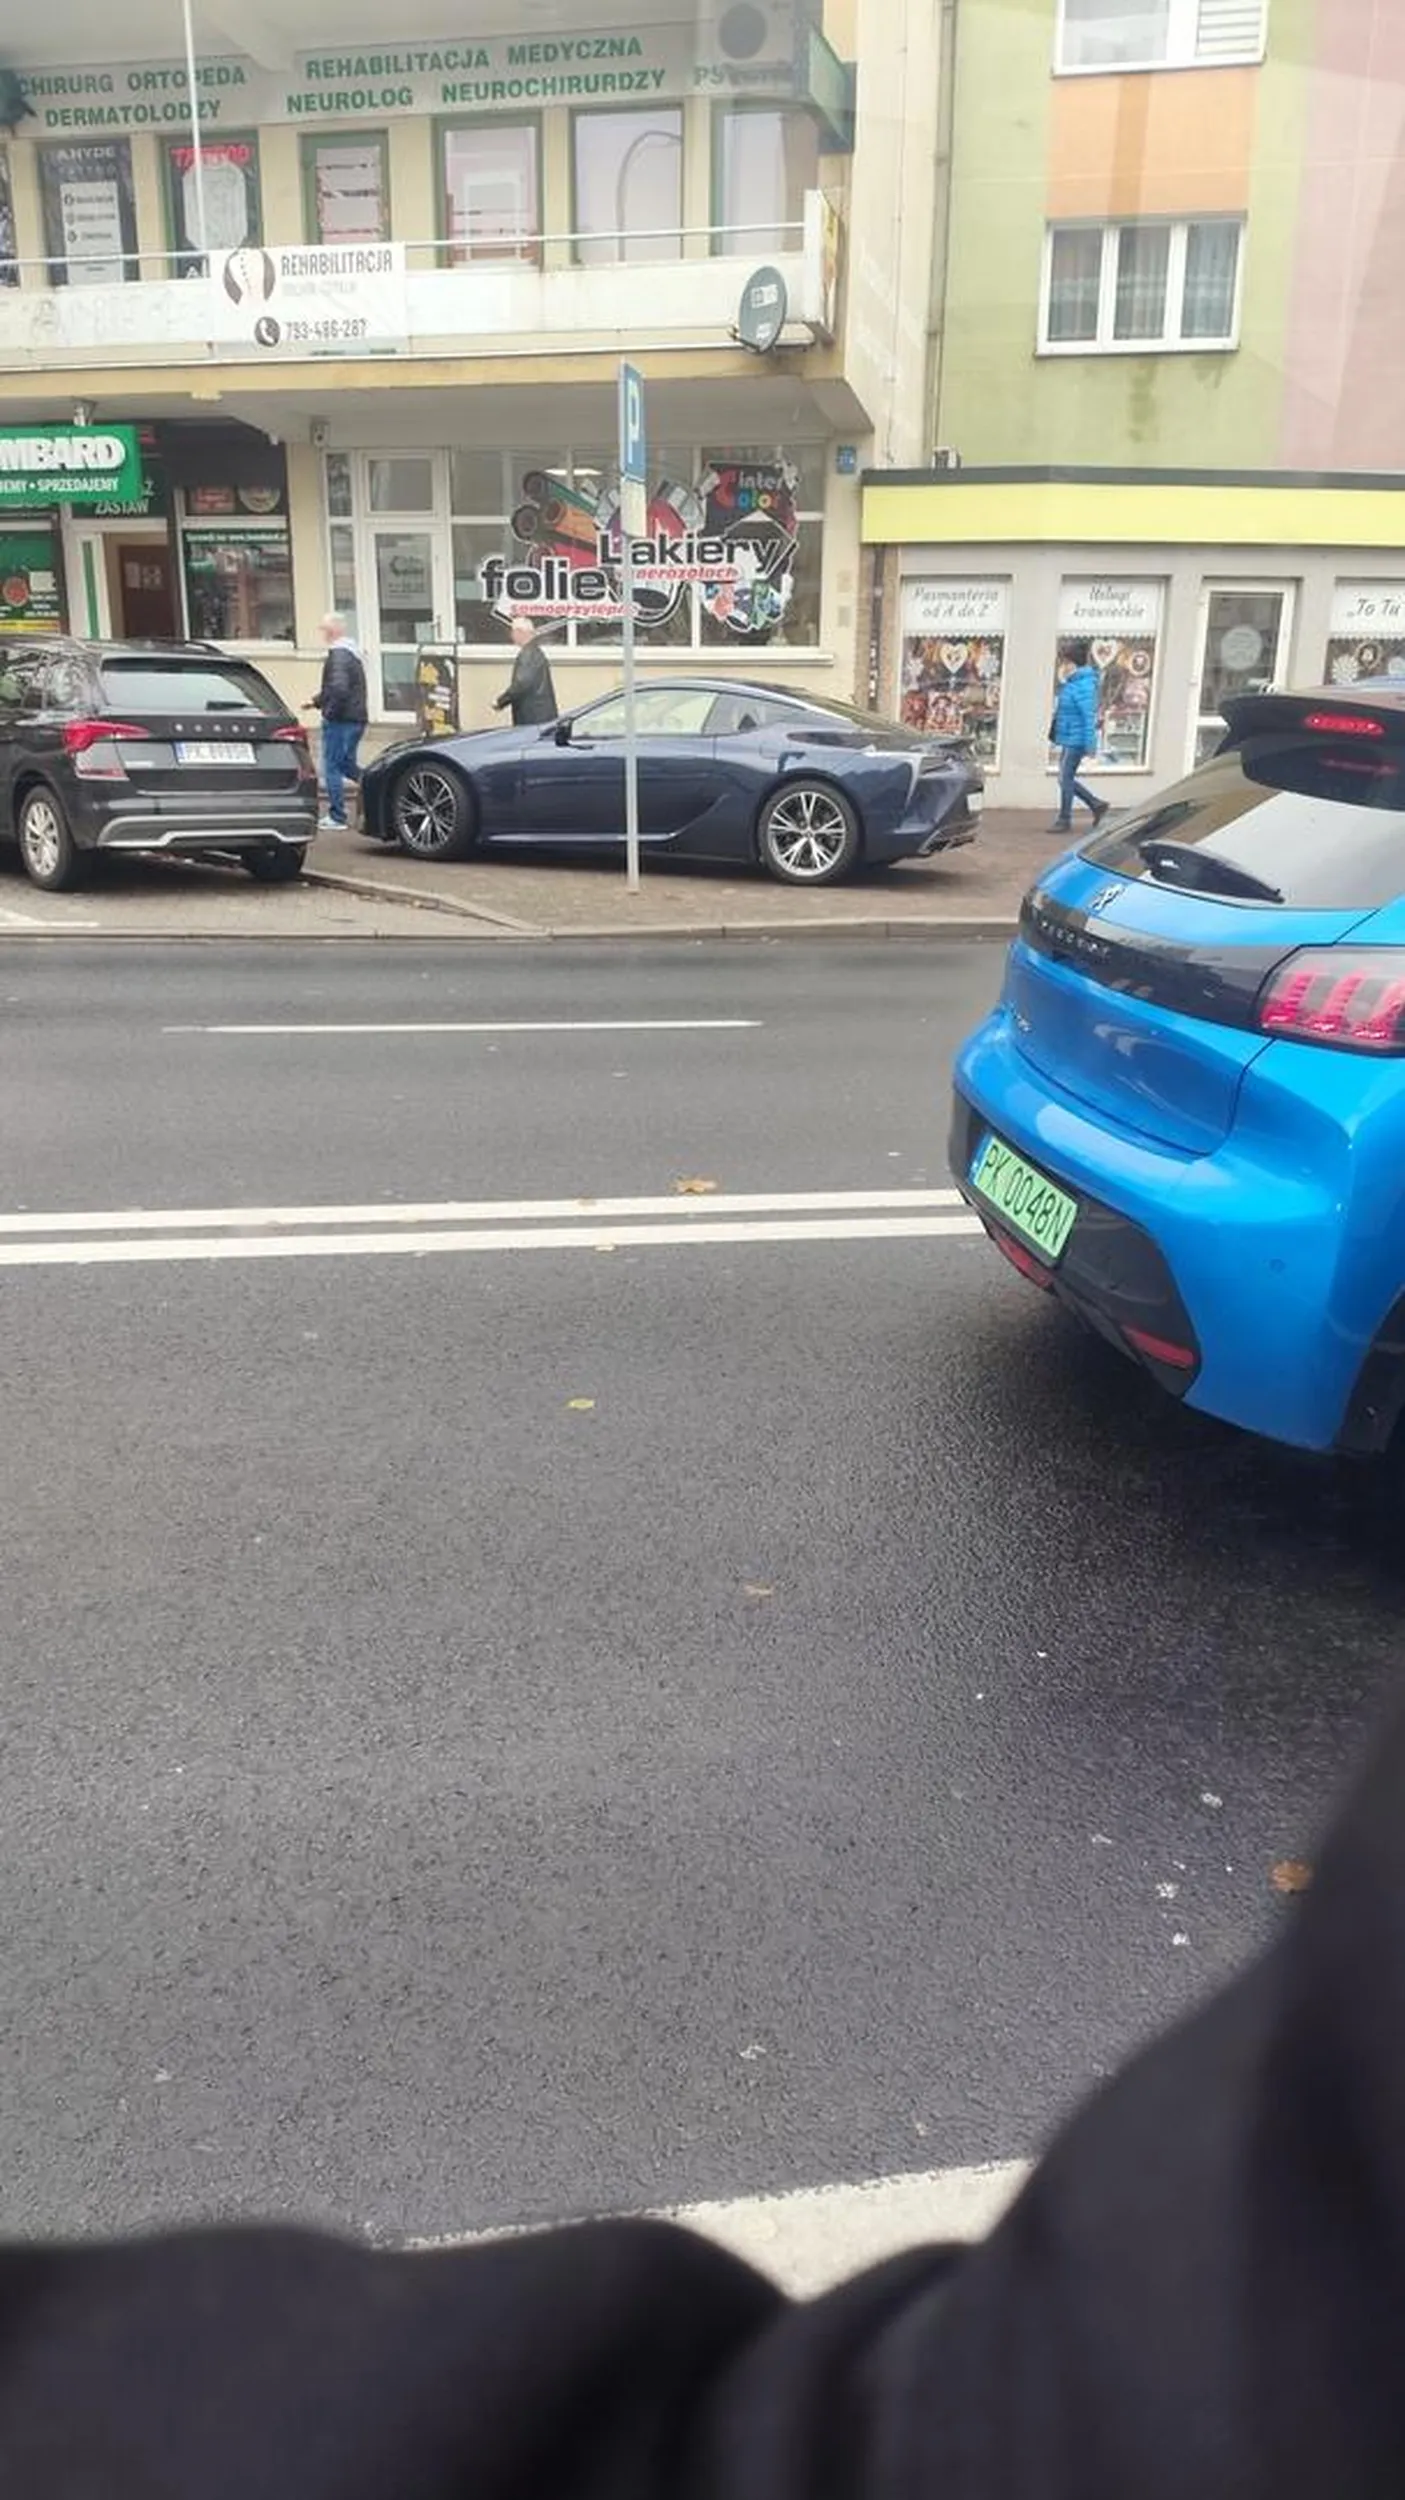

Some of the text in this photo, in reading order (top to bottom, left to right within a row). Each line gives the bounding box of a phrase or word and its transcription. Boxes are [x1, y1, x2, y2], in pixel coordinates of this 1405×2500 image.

[306, 36, 643, 80] REHABILITACJA MEDYCZNA
[19, 66, 246, 97] CHIRURG ORTOEDA
[287, 86, 413, 114] NEUROLOG
[442, 69, 666, 103] NEUROCHIRURDZY
[45, 99, 221, 127] DERMATOLODZY
[281, 250, 393, 276] REHABILITACJA
[627, 377, 640, 464] P
[37, 477, 119, 492] SPRZEDAJEMY
[600, 533, 780, 573] Lakiery
[481, 558, 607, 601] folie
[977, 1144, 1074, 1248] PK 0048N
